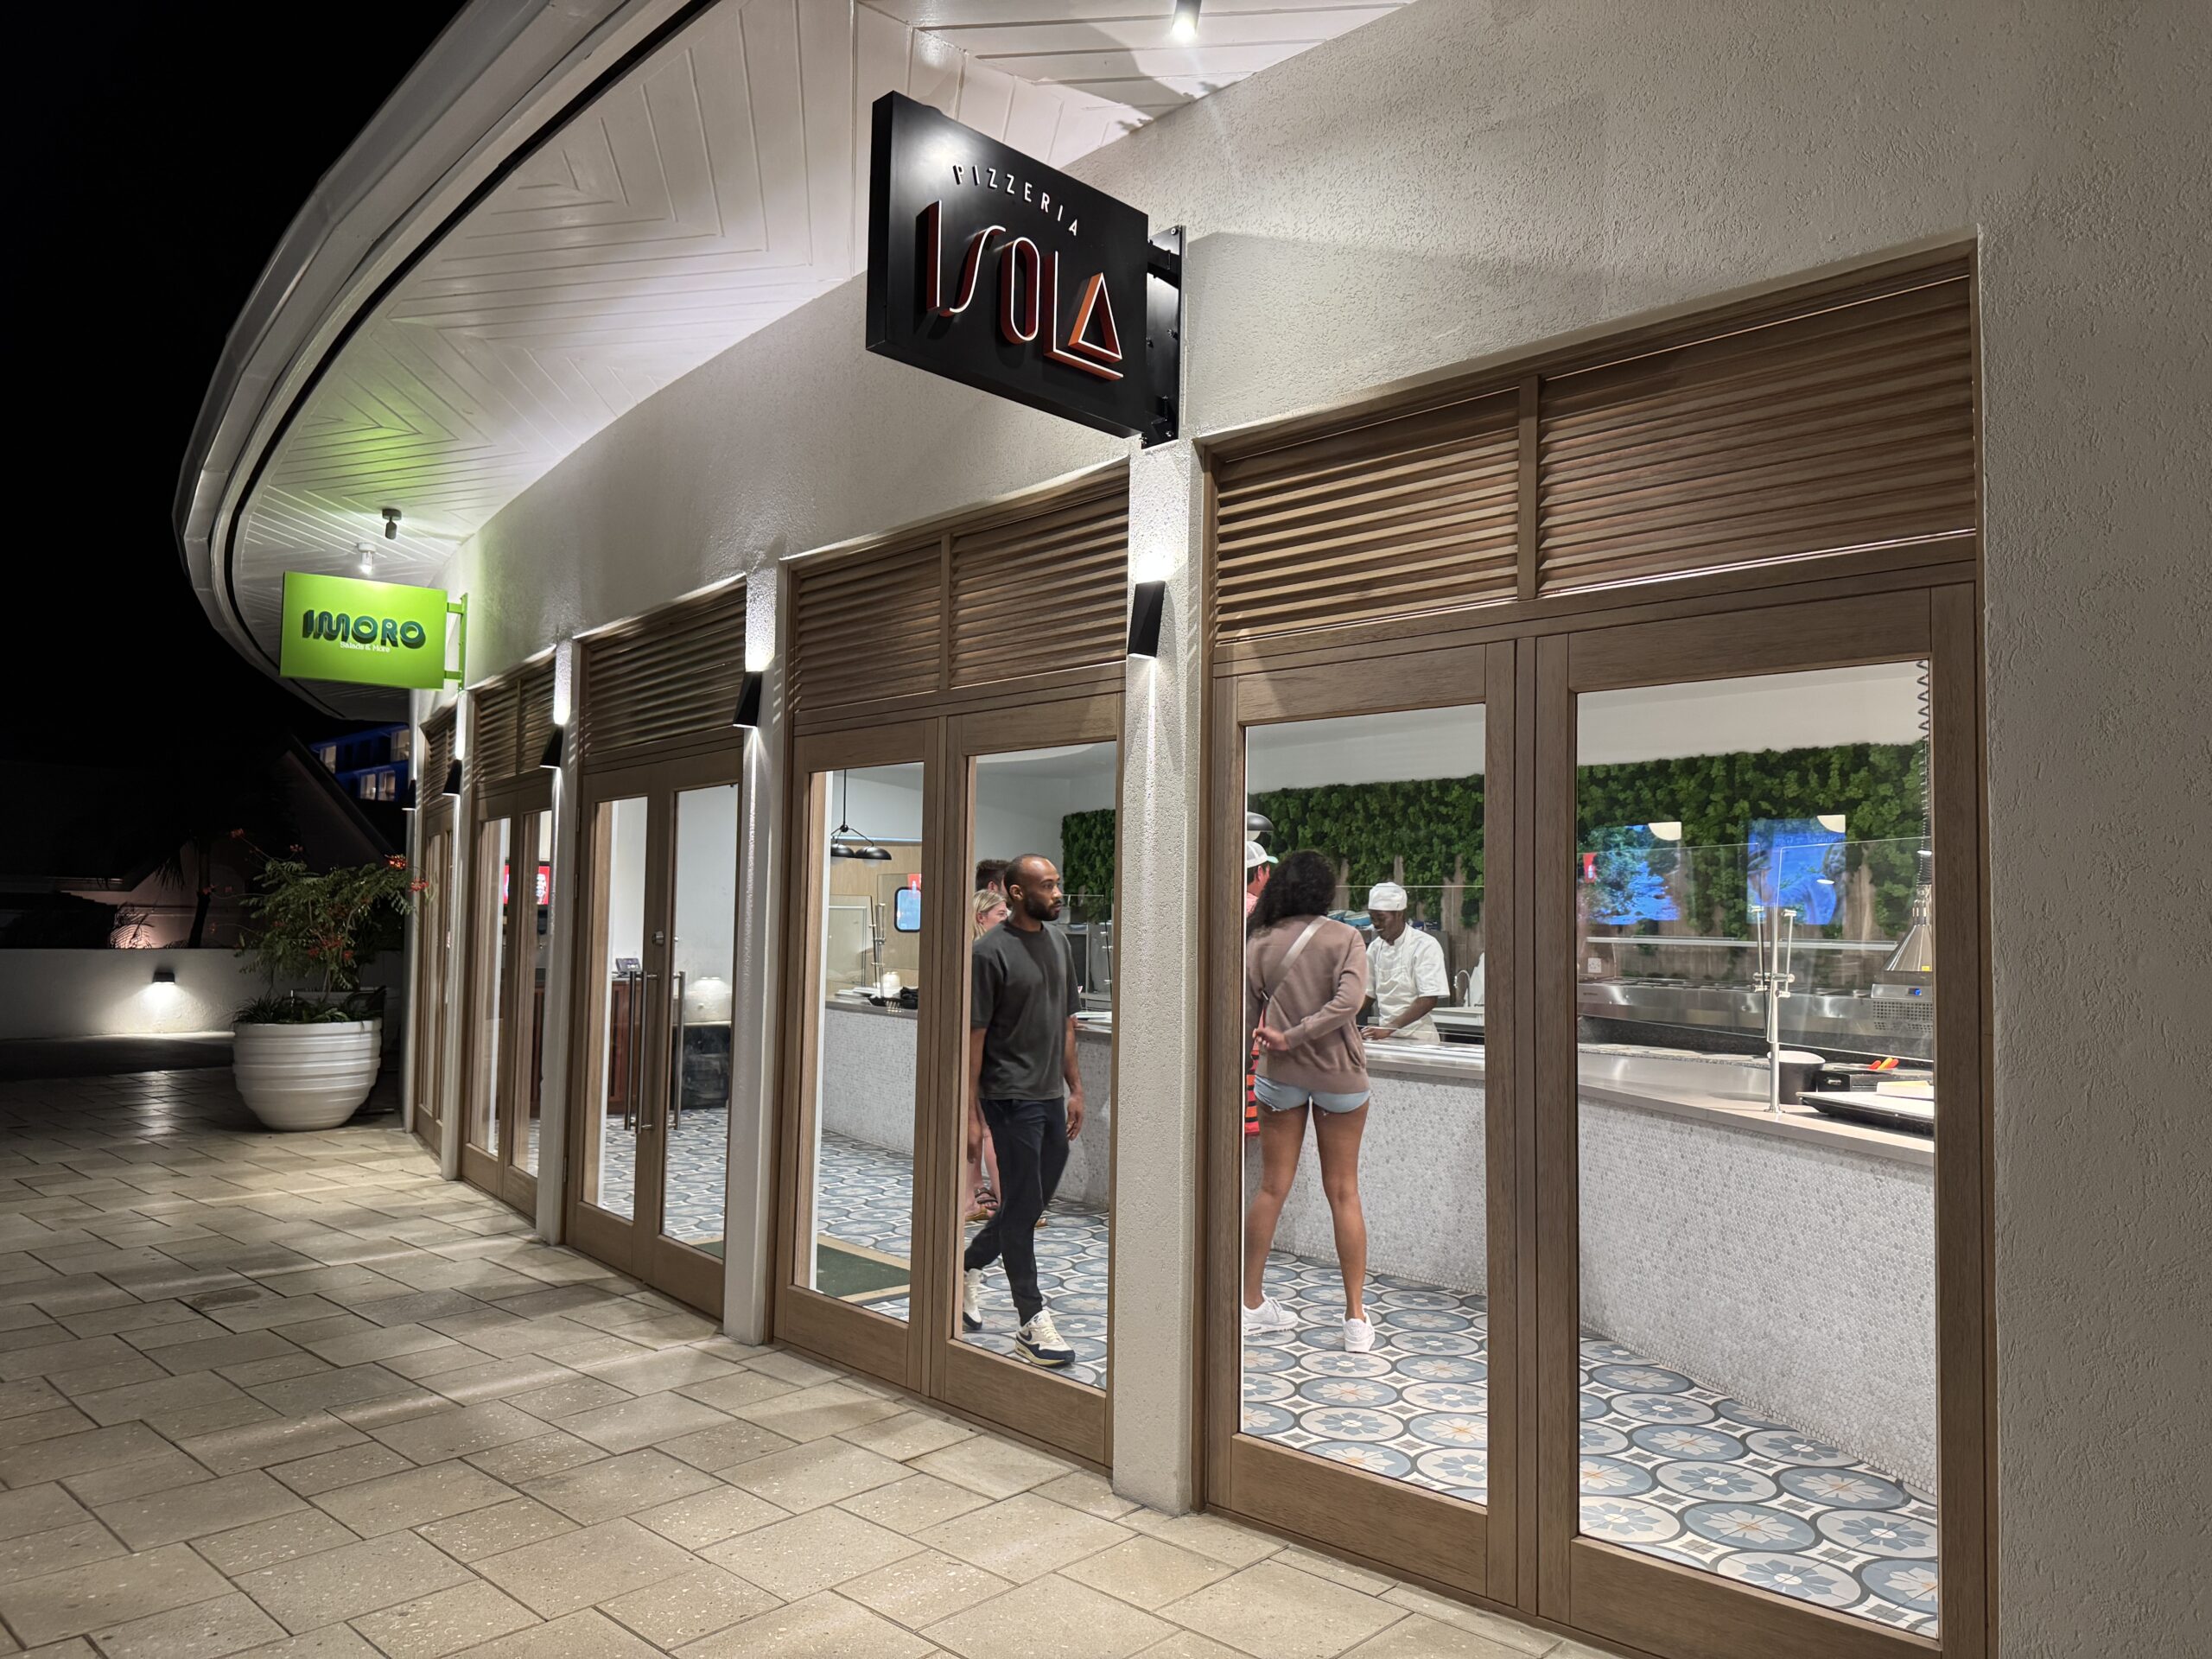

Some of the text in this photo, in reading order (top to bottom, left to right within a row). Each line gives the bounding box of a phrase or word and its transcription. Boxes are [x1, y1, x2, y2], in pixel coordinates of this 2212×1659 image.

[952, 164, 1078, 237] PIZZERIA
[928, 200, 1124, 380] ISOLA
[303, 609, 426, 649] IMORO
[340, 640, 364, 650] Salads
[372, 644, 391, 652] More
